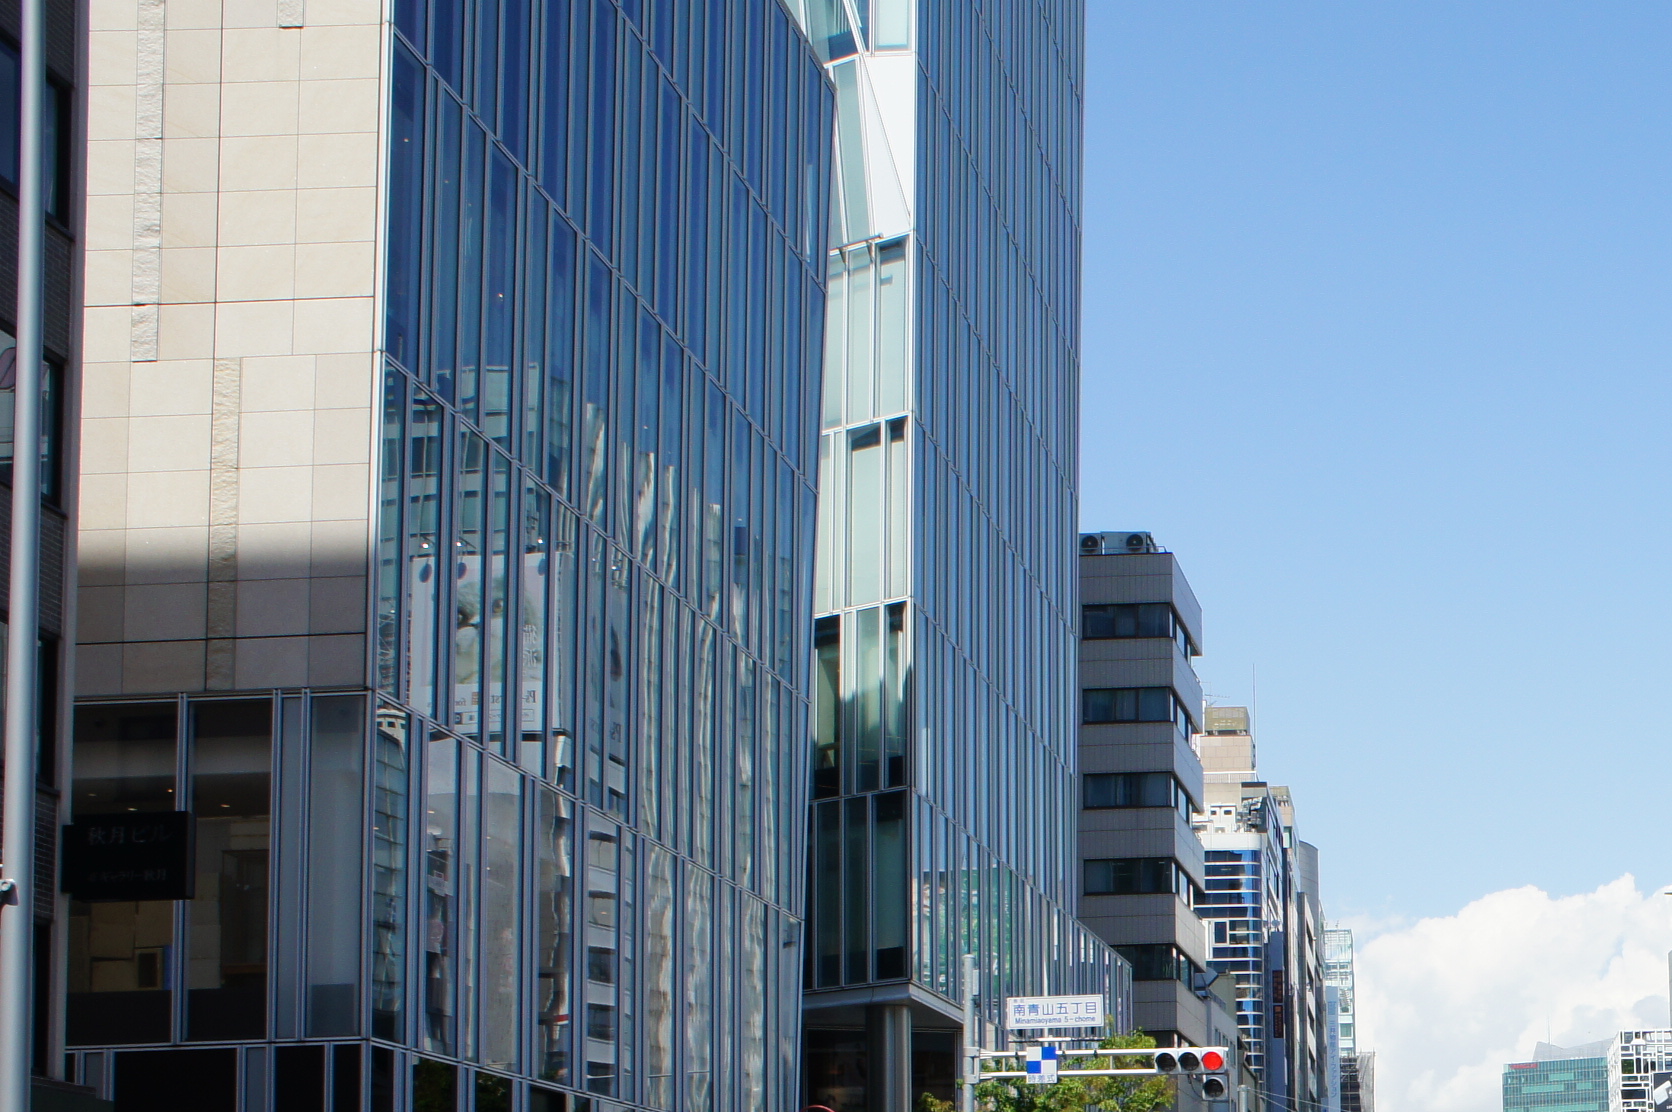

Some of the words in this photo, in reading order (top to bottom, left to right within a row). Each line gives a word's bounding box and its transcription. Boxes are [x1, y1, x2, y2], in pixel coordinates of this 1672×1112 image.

[86, 824, 174, 846] 秋月ビル
[1013, 1002, 1097, 1016] 南青山五丁目
